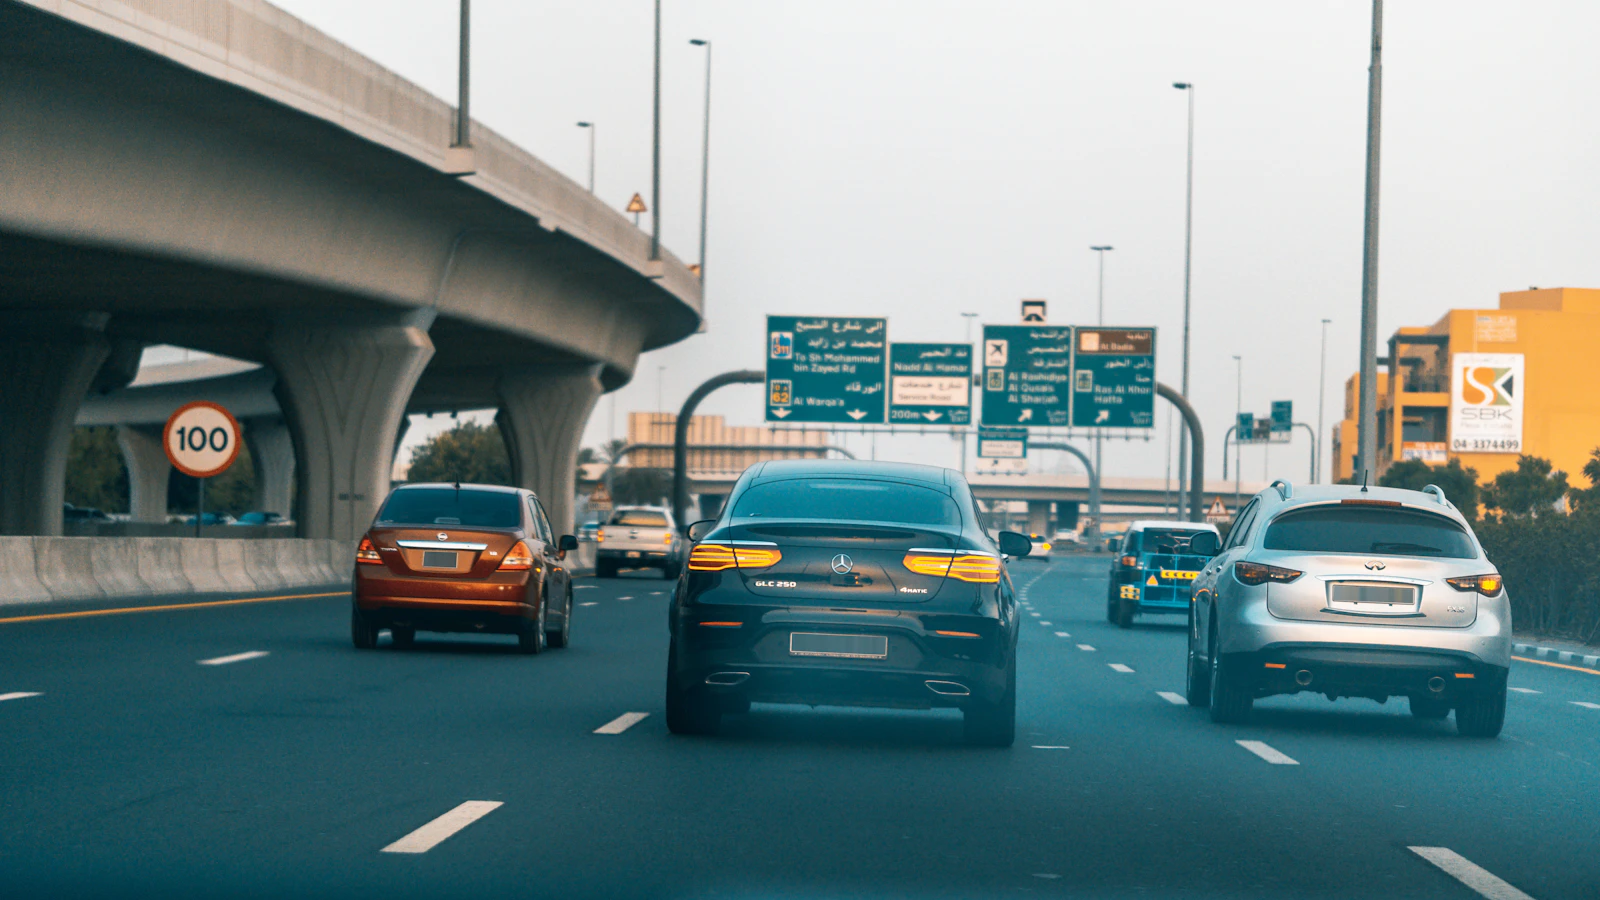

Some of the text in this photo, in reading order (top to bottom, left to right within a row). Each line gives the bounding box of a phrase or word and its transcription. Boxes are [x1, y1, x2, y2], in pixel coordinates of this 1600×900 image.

[796, 320, 828, 332] الشيخ
[832, 321, 862, 333] شارع
[808, 338, 829, 349] زايد
[773, 345, 789, 355] 311
[794, 353, 880, 363] To Sh Mohammed
[794, 364, 856, 374] bin Zayed Rd
[894, 362, 968, 372] Nadd Al Hamar
[1008, 372, 1018, 381] Al
[1008, 384, 1018, 392] Al
[1095, 384, 1150, 394] Ras Al Khor
[772, 392, 789, 402] 62
[1008, 394, 1018, 403] Al
[1094, 396, 1122, 404] Hatta
[794, 398, 844, 407] Al Warqa'a
[892, 410, 920, 419] 200m
[1460, 408, 1512, 420] SBK
[176, 426, 228, 452] 100
